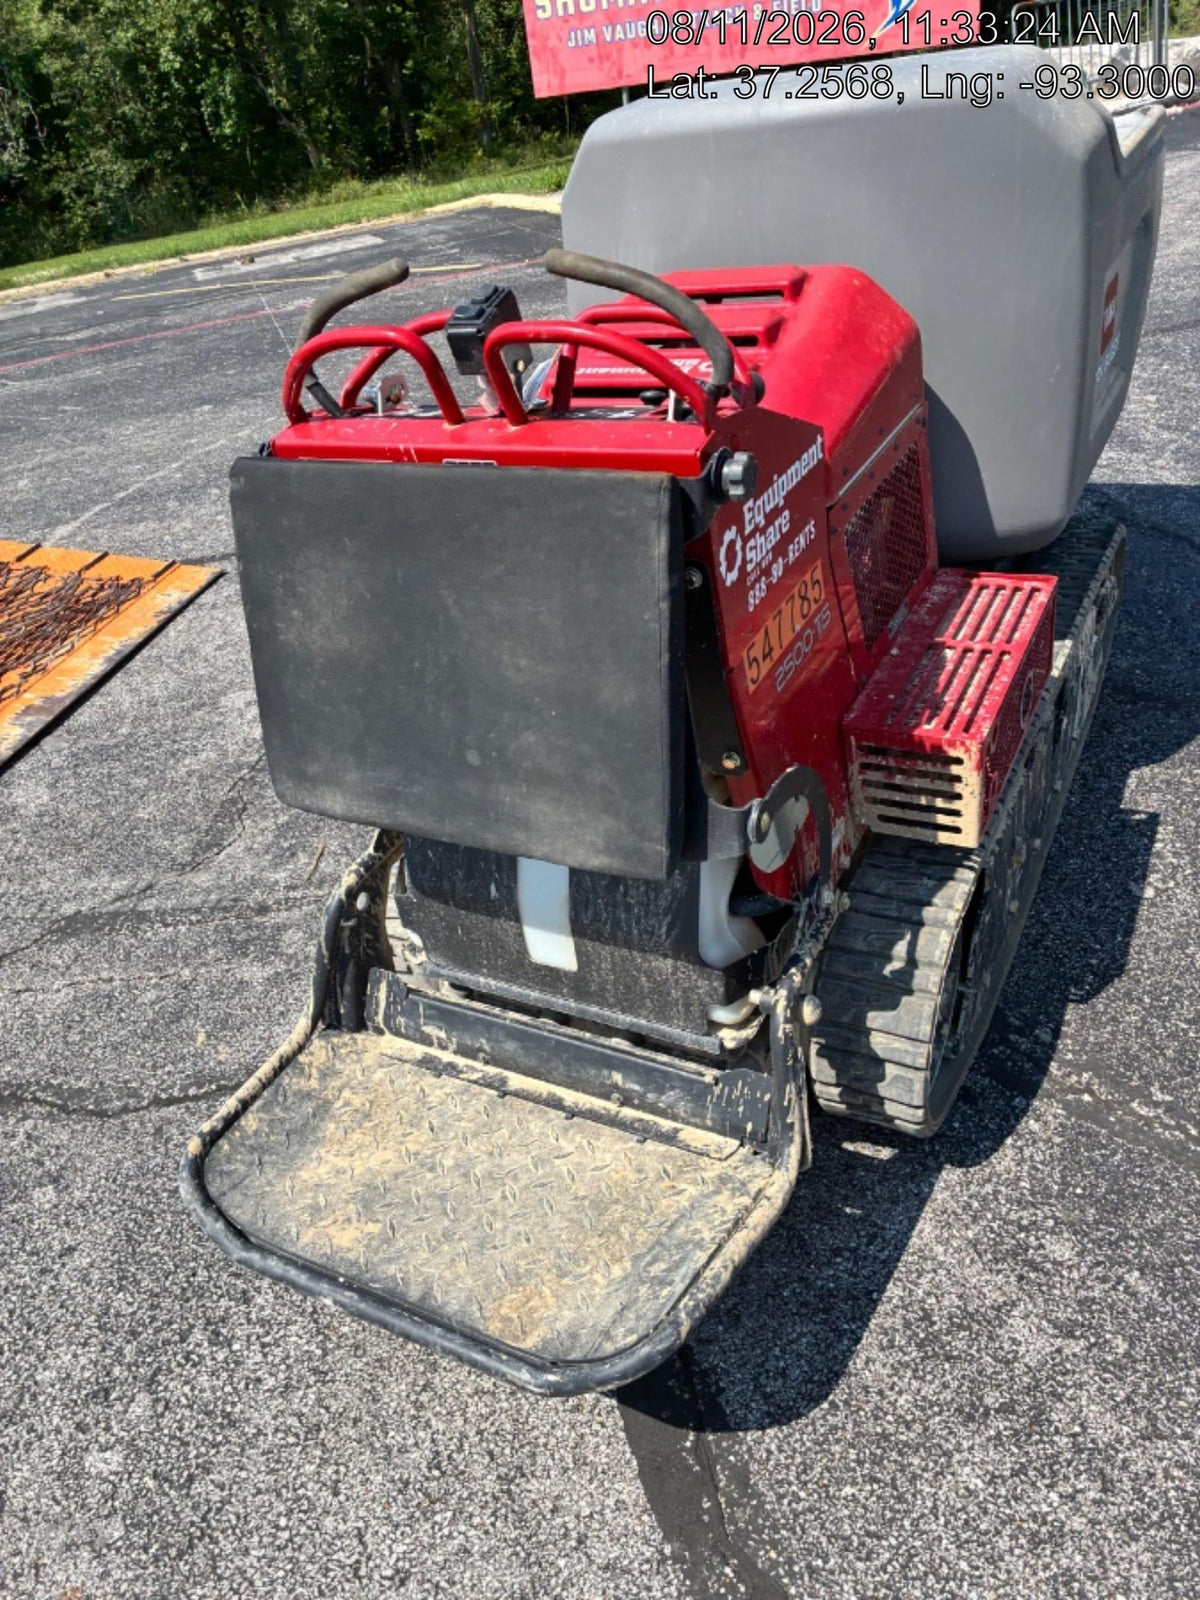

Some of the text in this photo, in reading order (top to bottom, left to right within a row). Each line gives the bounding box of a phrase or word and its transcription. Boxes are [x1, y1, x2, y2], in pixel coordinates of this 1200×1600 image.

[567, 26, 597, 48] JIM
[742, 432, 824, 534] Equipment
[745, 508, 791, 573] Share
[745, 564, 823, 687] 547785
